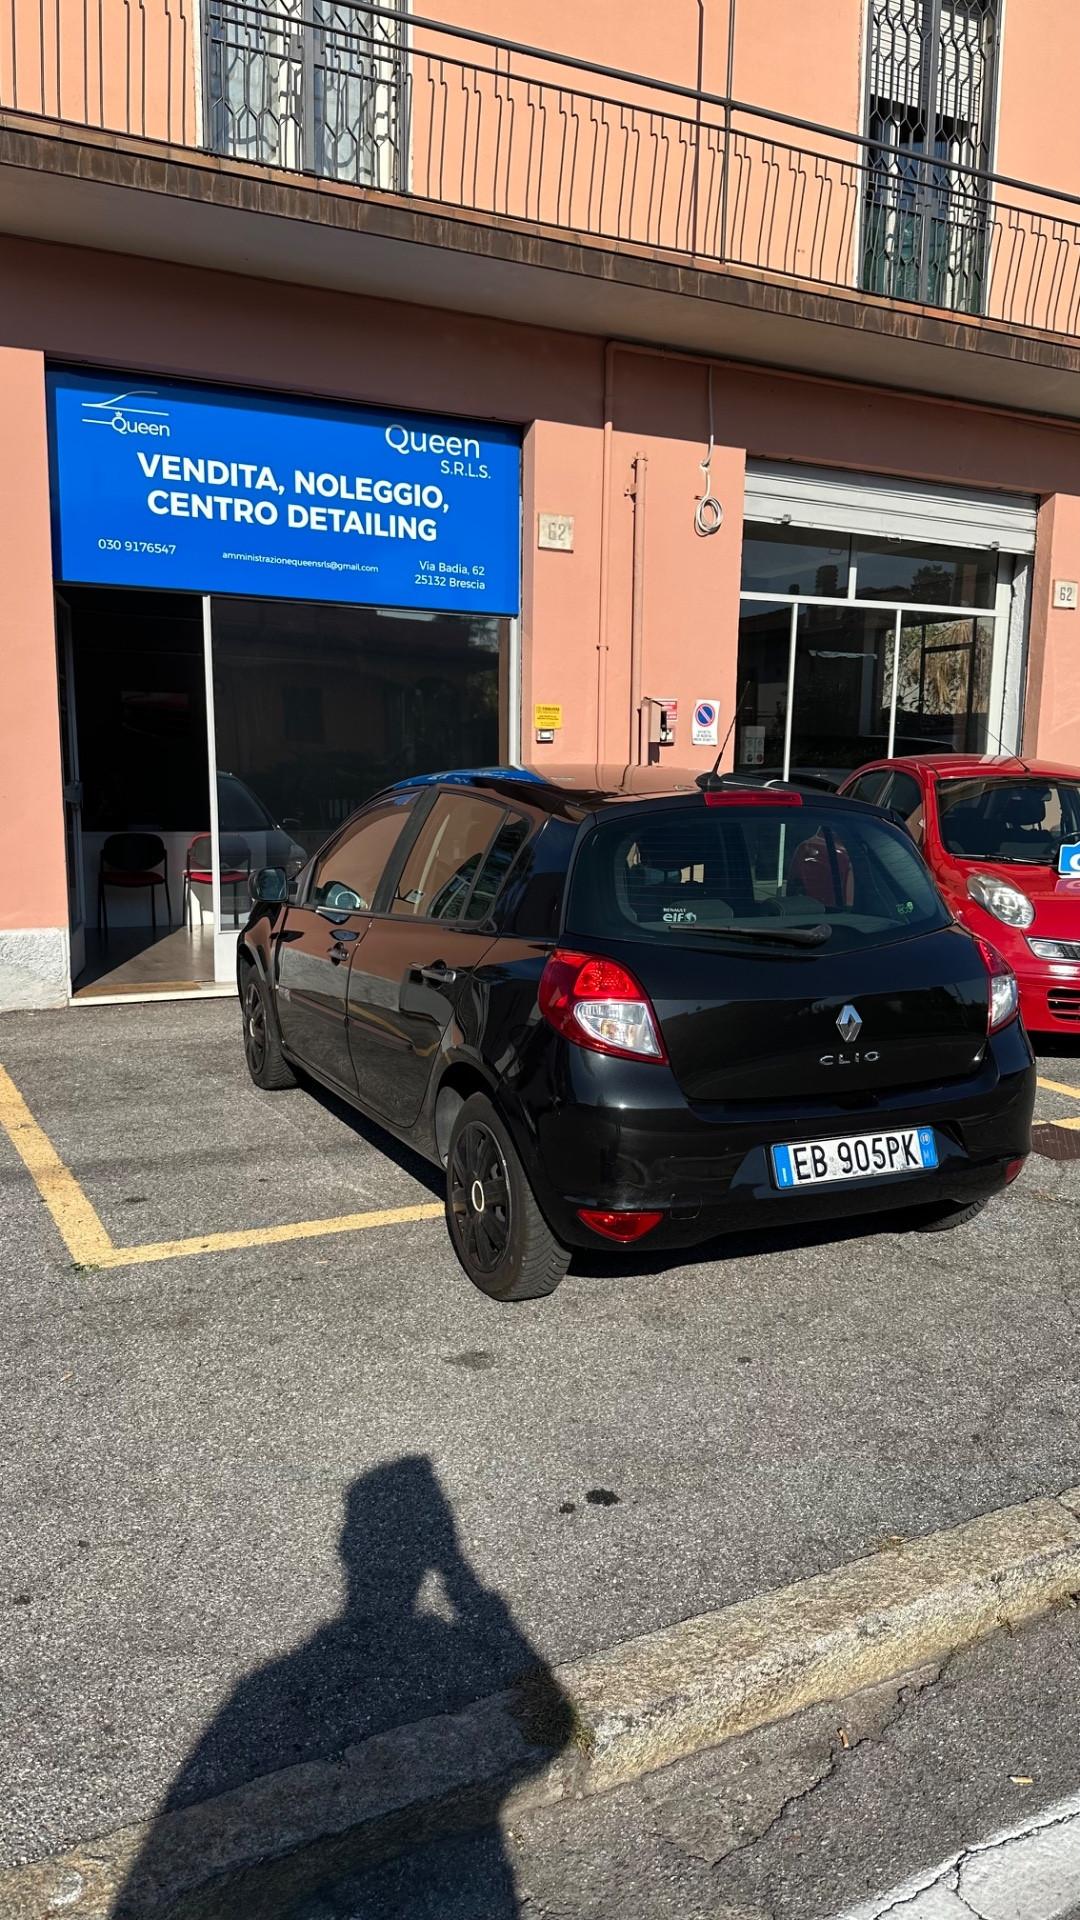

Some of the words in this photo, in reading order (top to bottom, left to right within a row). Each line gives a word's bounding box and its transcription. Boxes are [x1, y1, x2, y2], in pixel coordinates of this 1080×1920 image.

[111, 416, 170, 437] Queen
[385, 424, 480, 459] Queen
[440, 459, 492, 480] S.R.L.S.
[136, 451, 286, 496] VENDITA,
[294, 470, 450, 514] NOLEGGIO,
[147, 489, 279, 526] CENTRO
[287, 503, 438, 542] DETAILING
[97, 538, 122, 551] 030
[124, 541, 177, 555] 9176547
[222, 551, 379, 573] amministrazionequeensrls@gmail.com
[419, 560, 436, 571] Via
[438, 562, 470, 576] Badia,
[472, 565, 485, 576] 62
[414, 574, 446, 587] 25132
[449, 577, 486, 590] Brescia
[1060, 586, 1073, 602] 62
[662, 912, 685, 922] elf
[819, 1051, 879, 1066] CLIO
[792, 1144, 828, 1181] EB
[836, 1132, 920, 1175] 905PK
